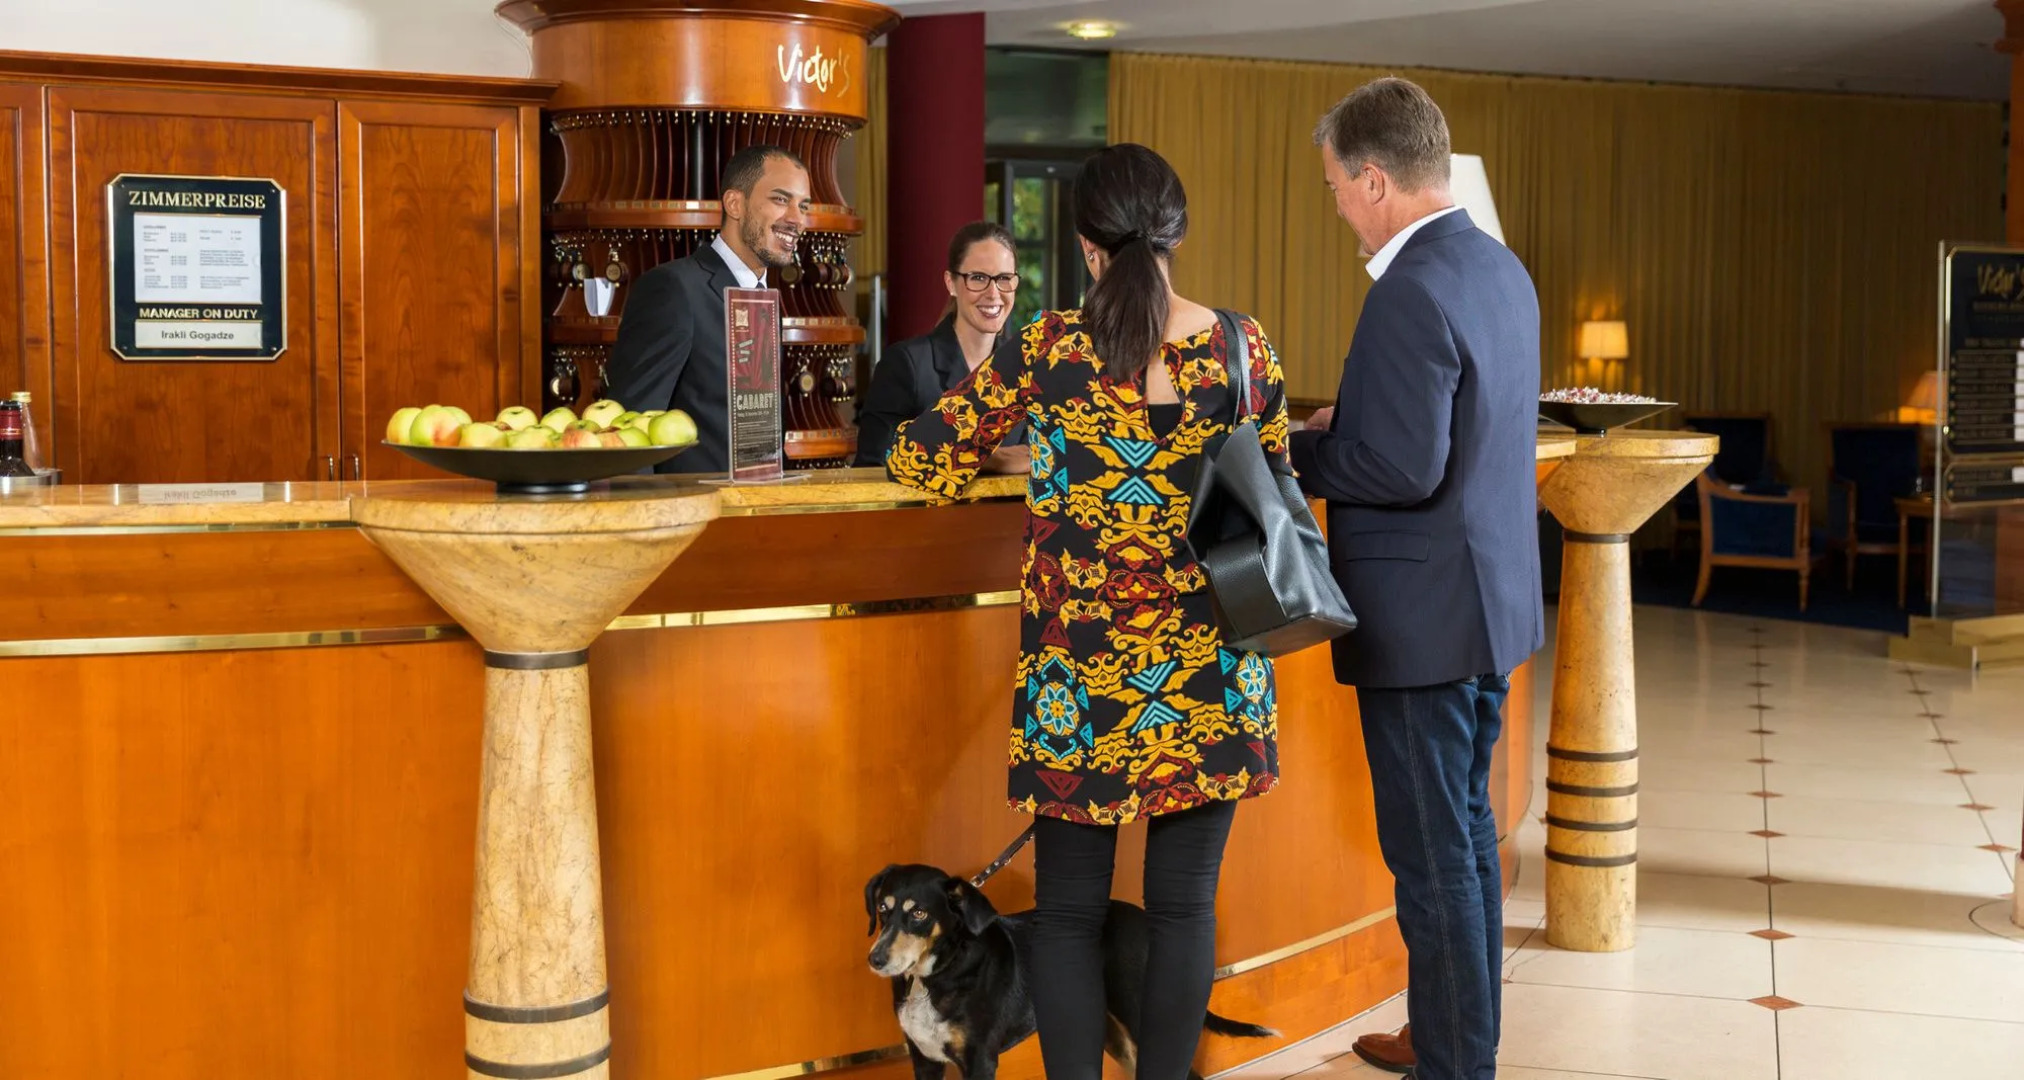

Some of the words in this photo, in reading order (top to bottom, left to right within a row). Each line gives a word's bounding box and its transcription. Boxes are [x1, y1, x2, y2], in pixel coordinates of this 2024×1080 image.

[777, 43, 850, 98] Victor's
[129, 191, 266, 209] ZIMMERPREISE
[139, 308, 200, 319] MANAGER
[202, 308, 222, 319] ON
[224, 308, 258, 319] DUTY
[161, 330, 187, 340] Irakli
[189, 330, 235, 342] Gogadze
[736, 393, 774, 411] CABARET
